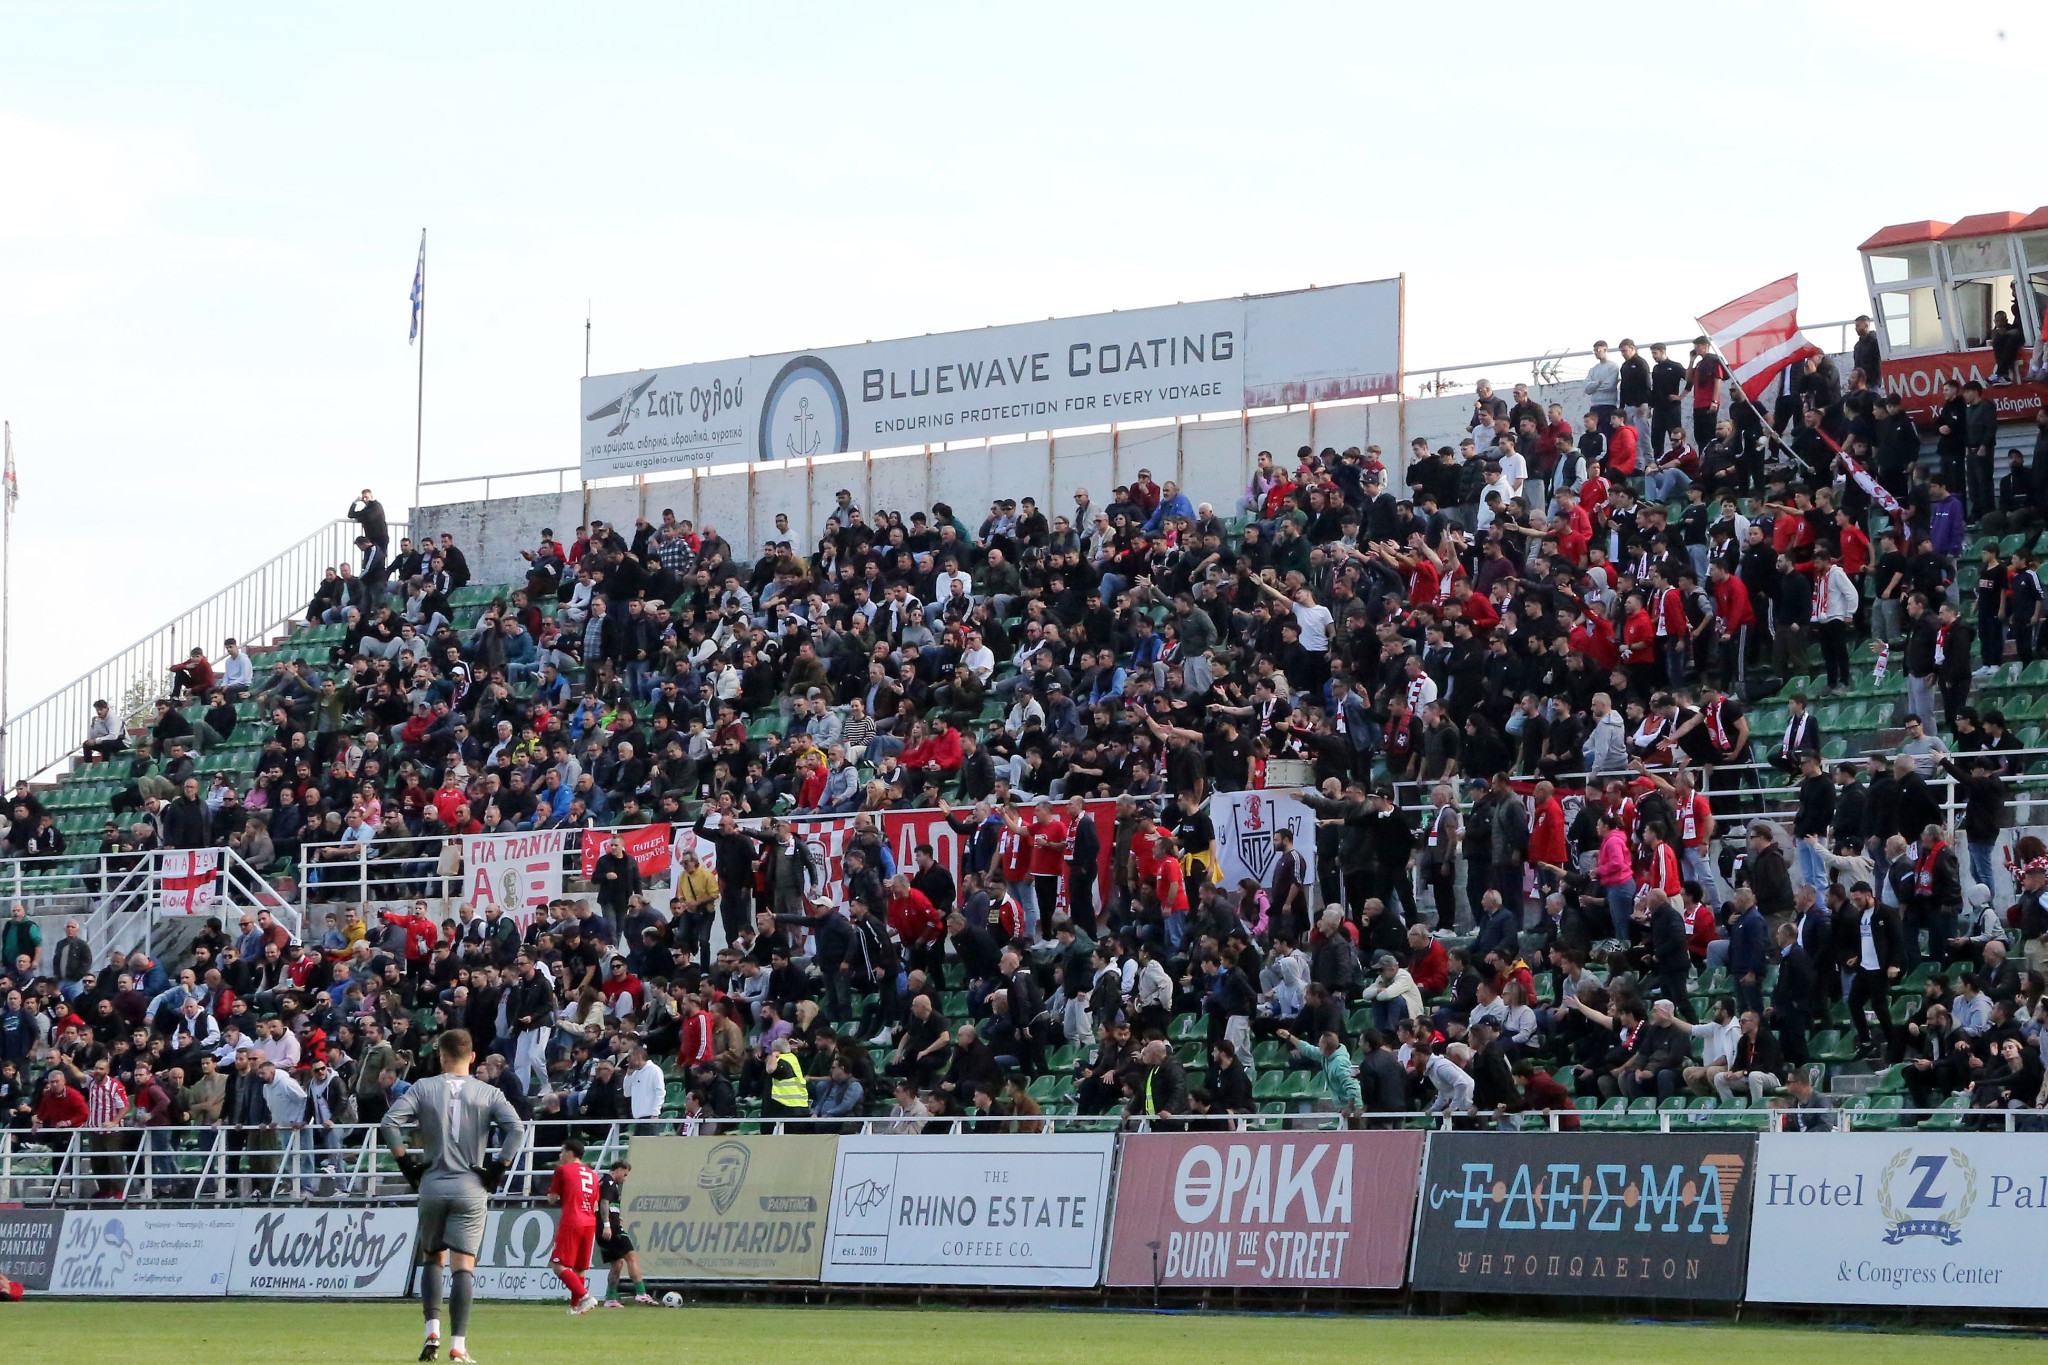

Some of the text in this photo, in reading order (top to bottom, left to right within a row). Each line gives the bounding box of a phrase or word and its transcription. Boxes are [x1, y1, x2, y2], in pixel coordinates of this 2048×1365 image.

[647, 377, 743, 422] Σαϊτ Ογλού
[875, 381, 1222, 434] ENDURING PROTECTION FOR EVERY VOYAGE
[1993, 393, 2042, 412] Σιδηρικά
[471, 832, 562, 865] ΓΙΑ ΠΑΝΤΑ
[579, 1170, 594, 1194] 2
[984, 1170, 1009, 1183] THE
[1765, 1174, 1865, 1207] Hotel
[1906, 1155, 1949, 1209] Z
[636, 1197, 682, 1210] DETAILING
[768, 1197, 810, 1210] PAINTING
[1454, 1163, 1729, 1233] ΕΔΕΣΜΑ
[898, 1195, 1087, 1228] RHINO ESTATE
[0, 1223, 53, 1238] ΜΑΡΓΑΡΙΤΑ
[65, 1217, 102, 1260] My
[647, 1220, 816, 1253] MOUHTARIDIS
[842, 1246, 878, 1257] est. 2019
[942, 1241, 1033, 1257] COFFEE CO.
[1164, 1230, 1350, 1279] BURN THE STREET
[13, 1261, 46, 1275] STUDIO
[1457, 1251, 1700, 1279] ΨΗΤΟΠΩΛΕΙΟΝ
[1837, 1260, 2003, 1290] & Congress Center
[250, 1276, 306, 1289] ΚΟΣΜΗΜΑ
[316, 1275, 349, 1289] ΡΟΛΟΪ
[498, 1272, 527, 1293] Καφέ
